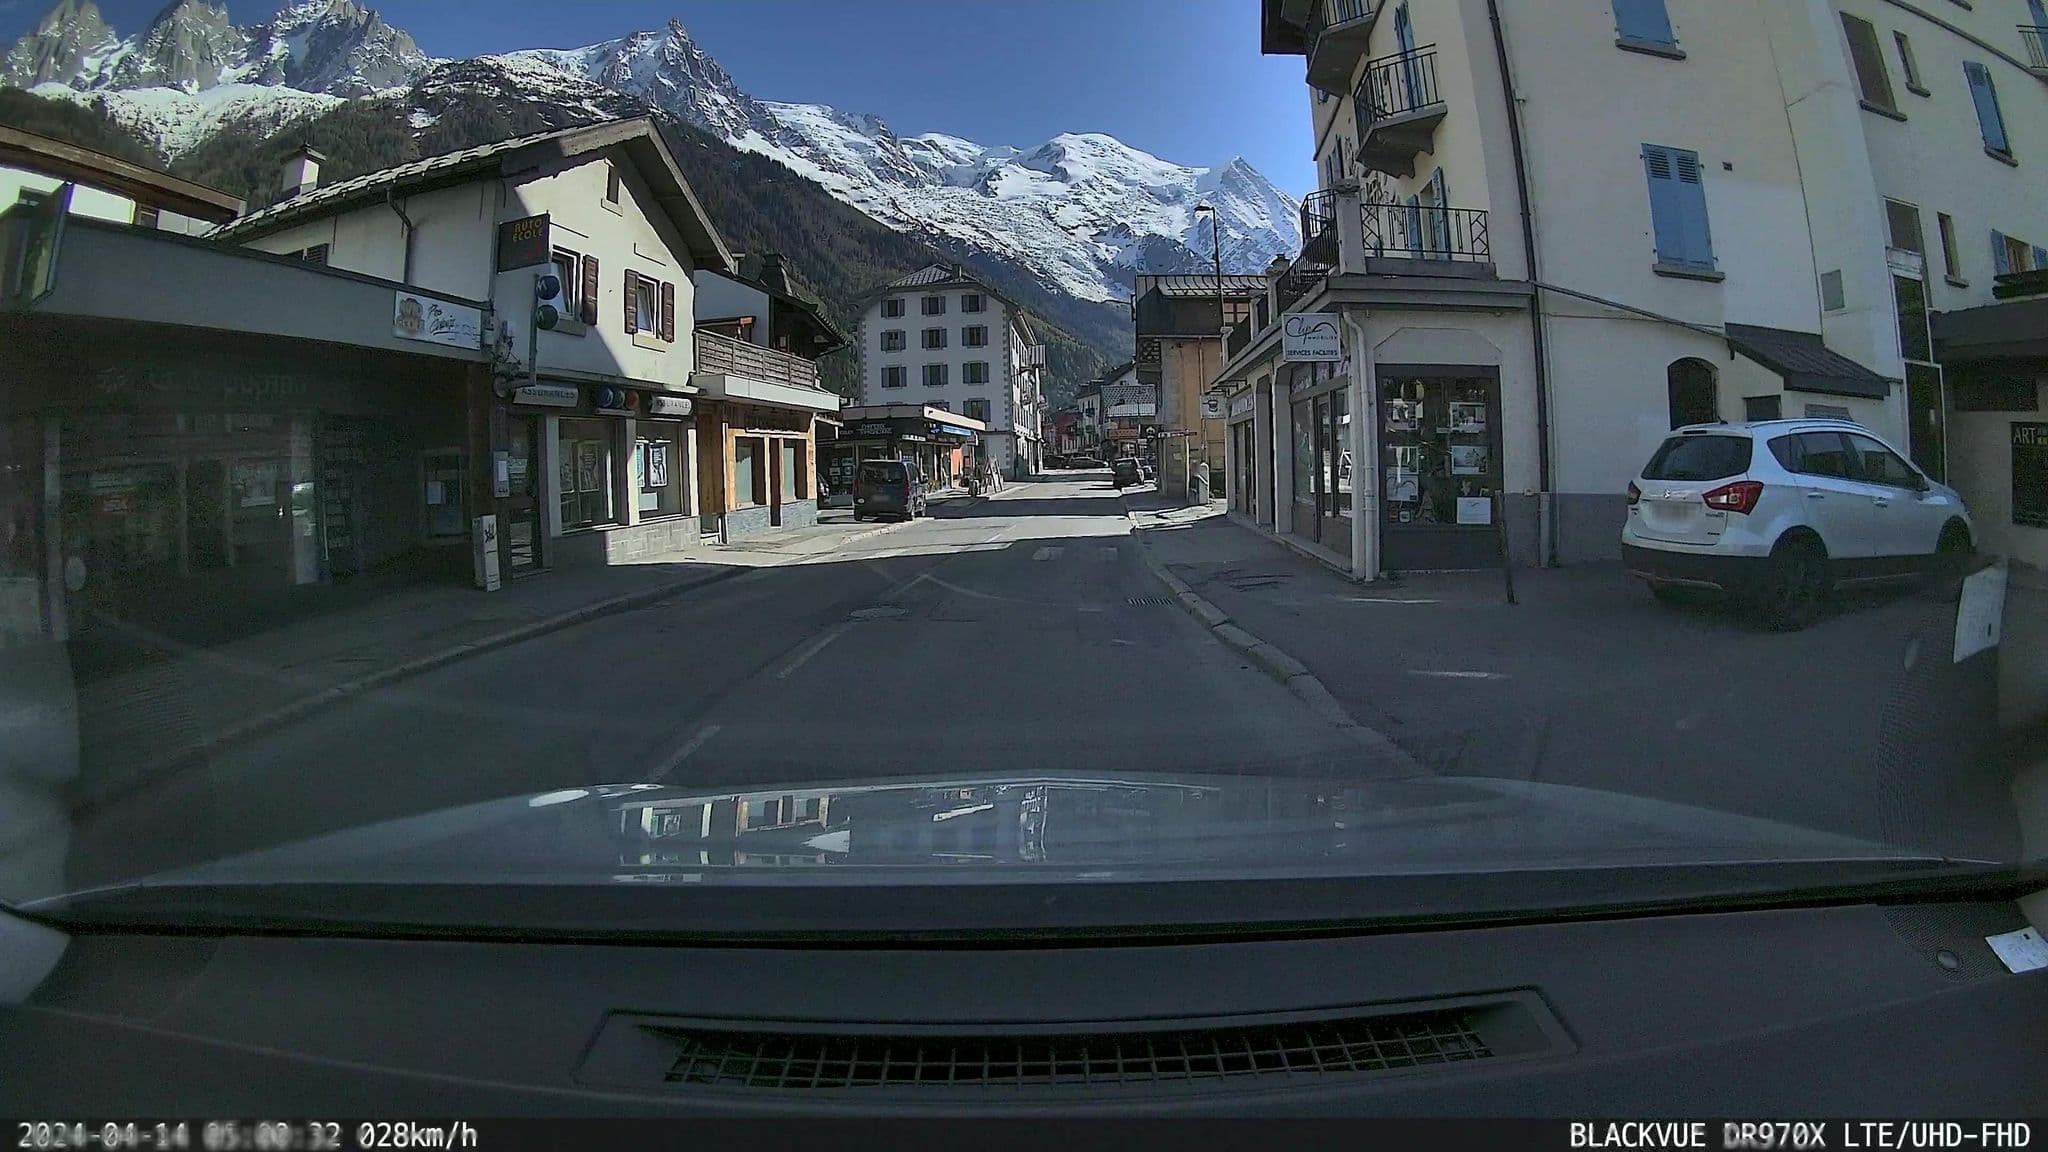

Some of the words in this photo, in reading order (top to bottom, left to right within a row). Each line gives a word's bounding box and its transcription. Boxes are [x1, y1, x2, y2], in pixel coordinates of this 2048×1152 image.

[514, 219, 541, 234] AUTO
[512, 228, 543, 242] ECOLE
[521, 388, 576, 399] ASSURANCES
[2013, 427, 2037, 444] ART
